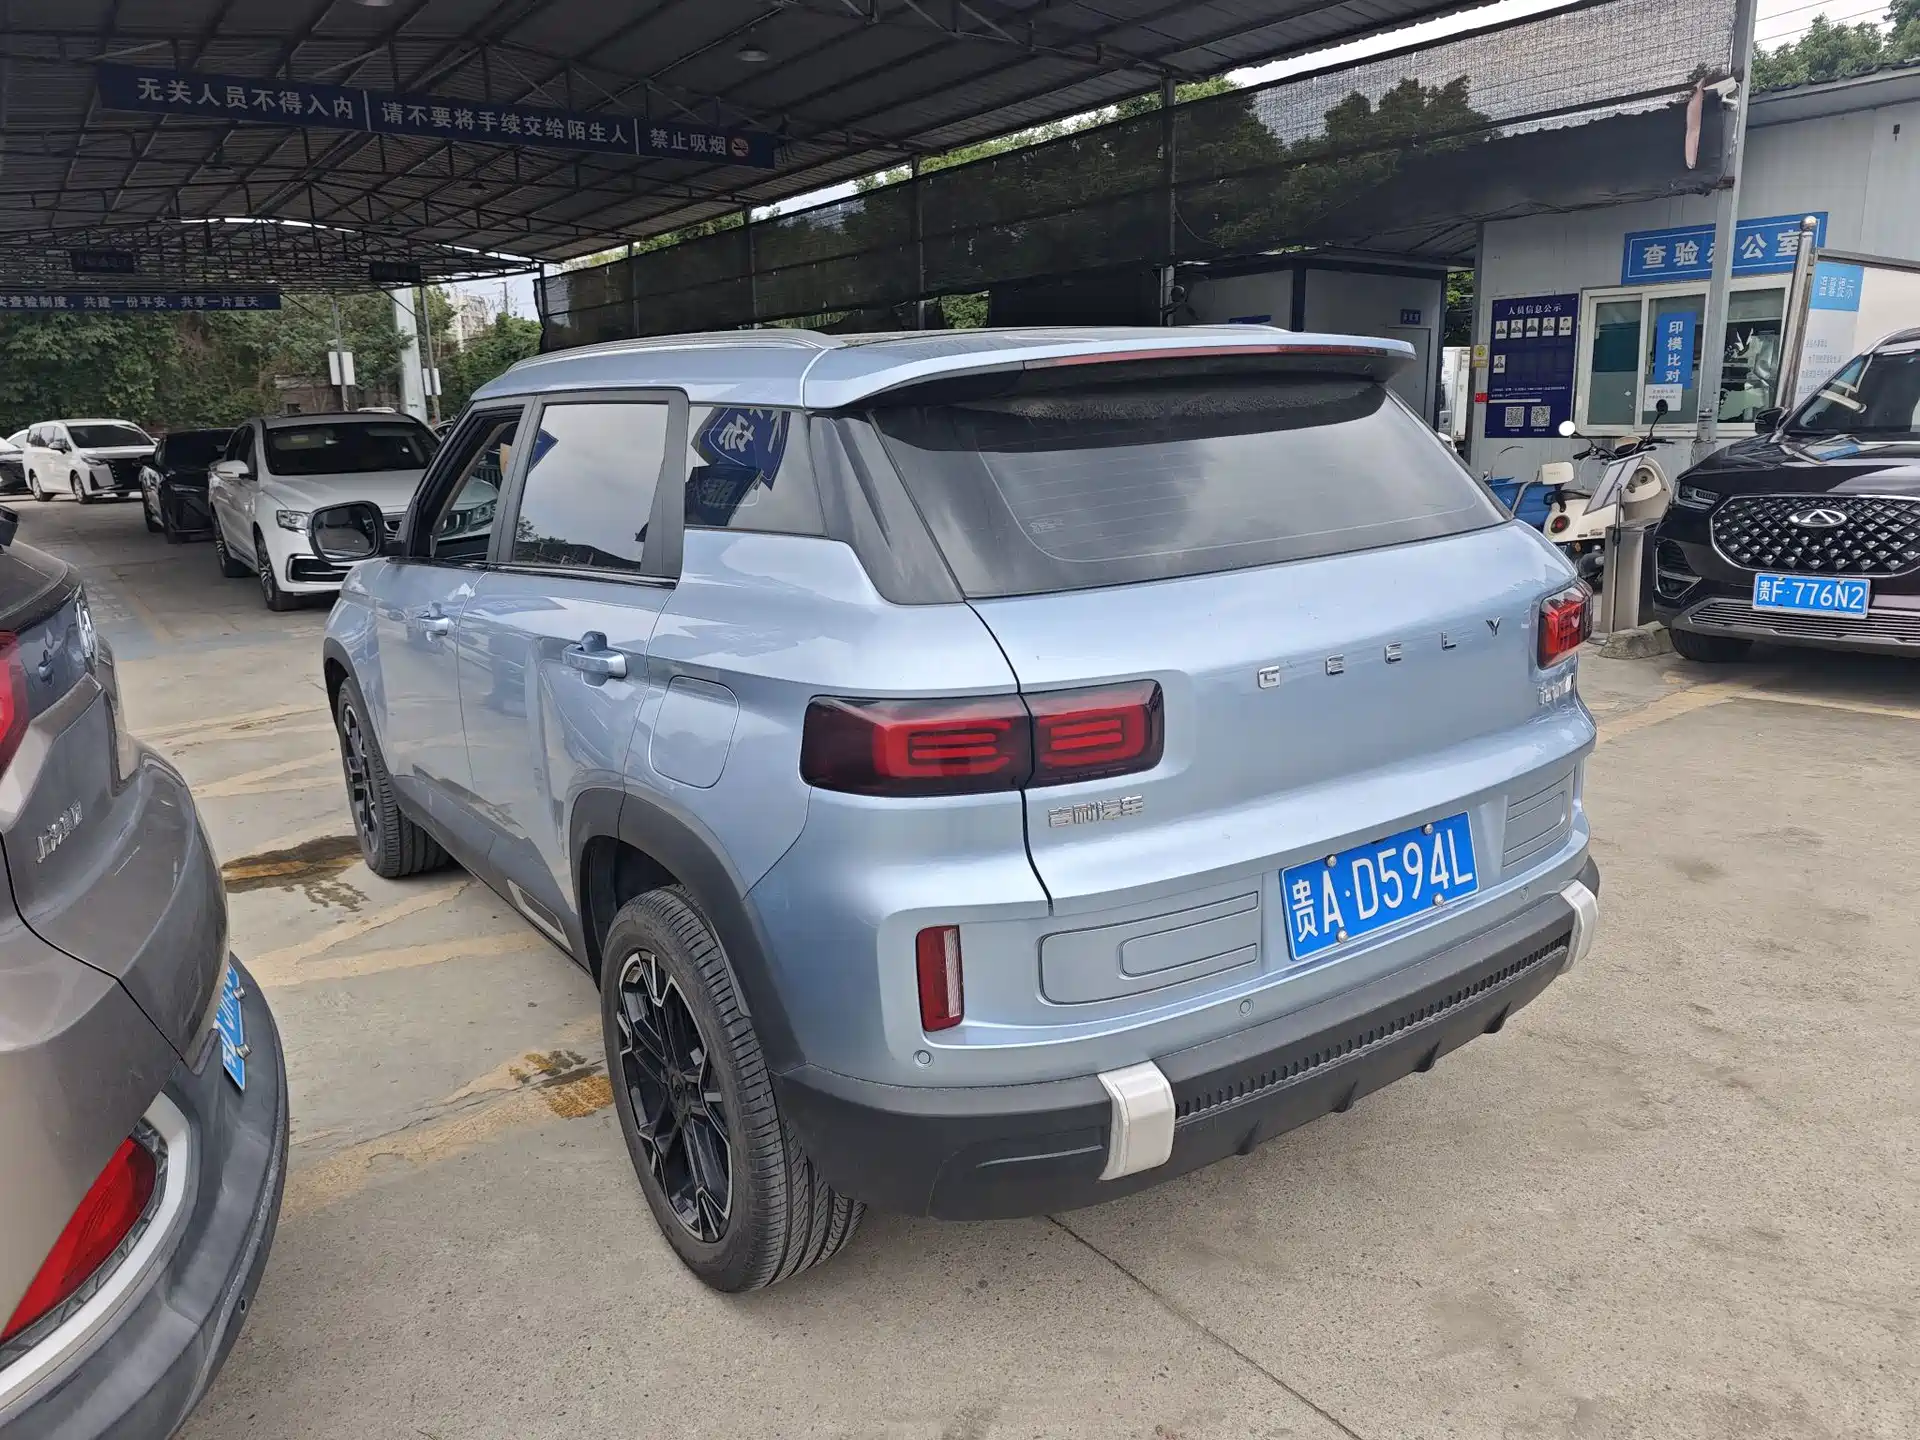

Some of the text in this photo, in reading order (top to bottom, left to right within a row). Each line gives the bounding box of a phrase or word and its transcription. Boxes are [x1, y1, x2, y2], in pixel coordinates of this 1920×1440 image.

[136, 77, 354, 119] 无关人员不得入内
[381, 101, 629, 144] 请不要将手续交给陌生人
[649, 127, 728, 156] 禁止吸烟
[1642, 228, 1801, 269] 查验公室
[1508, 303, 1562, 316] 人员信息公示
[1665, 320, 1684, 383] 印模比对
[1256, 615, 1502, 690] GEELY
[1047, 794, 1144, 828] 吉利汽车
[1291, 828, 1474, 943] 贵A·D594L
